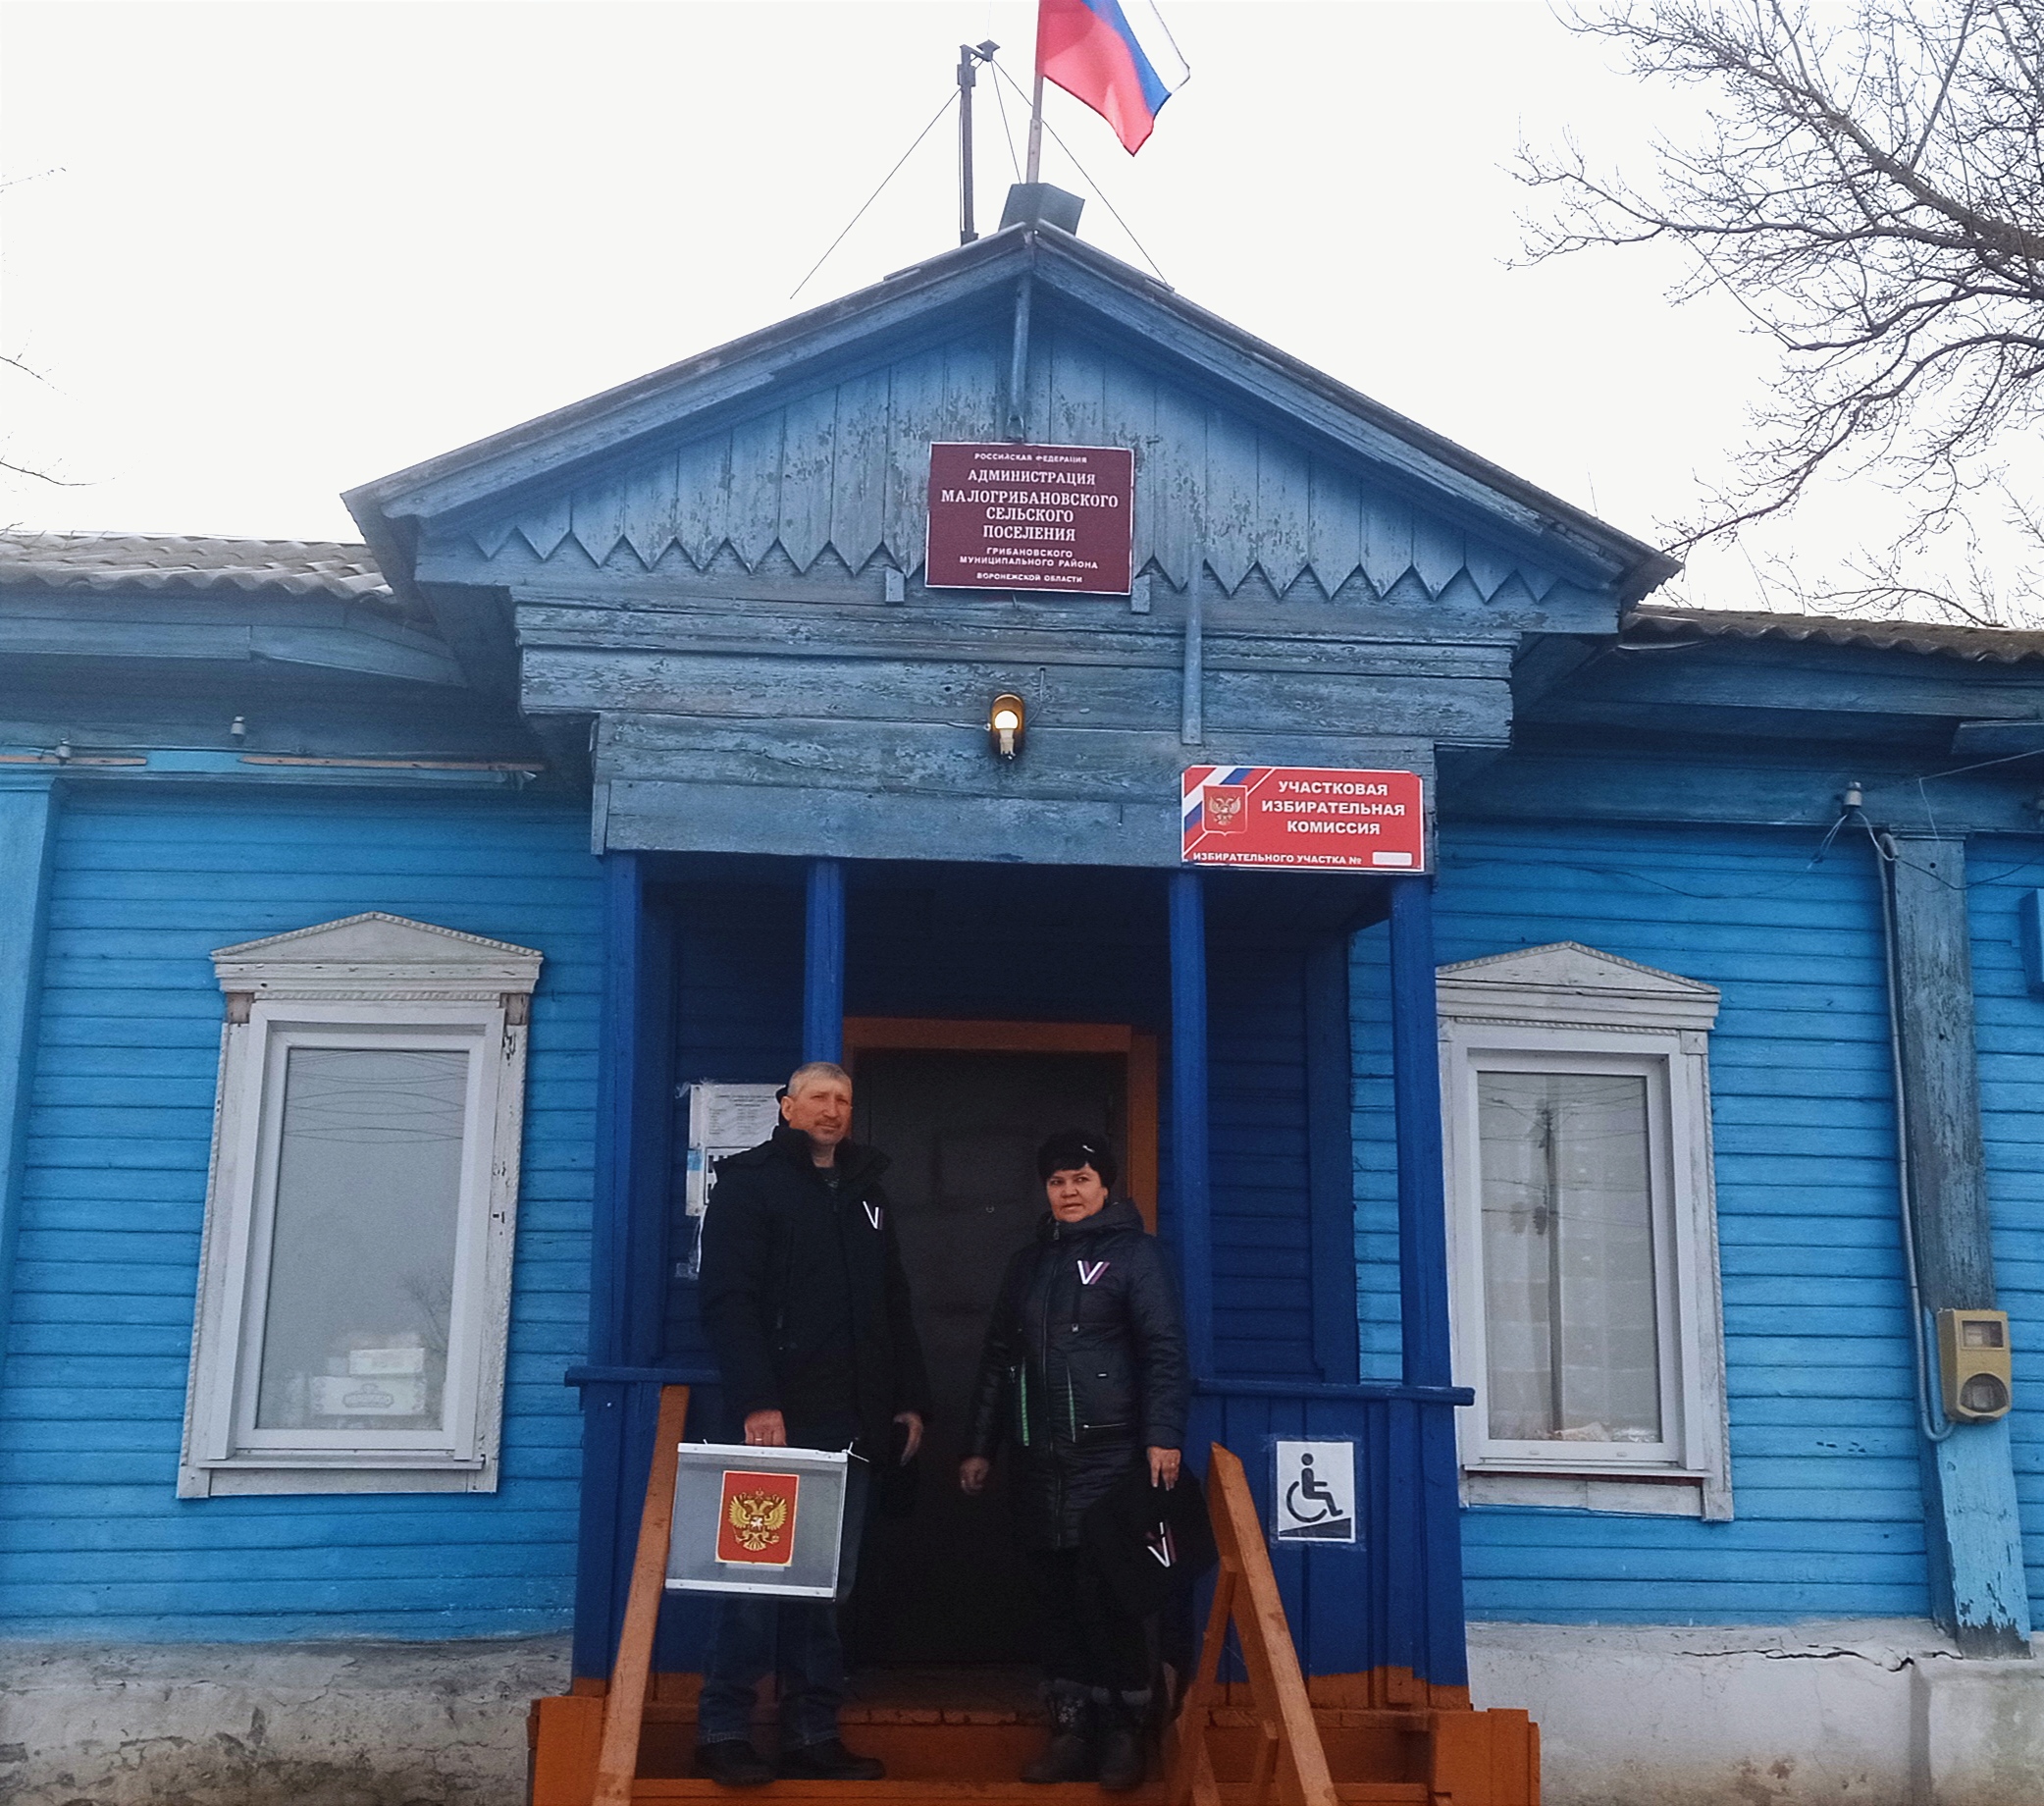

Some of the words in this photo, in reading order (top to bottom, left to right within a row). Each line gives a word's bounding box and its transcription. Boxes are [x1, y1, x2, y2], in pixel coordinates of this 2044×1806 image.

[974, 452, 1032, 461] РОССИЙСКАЯ
[1035, 454, 1087, 463] ФЕДЕРАЦИЯ
[968, 469, 1096, 486] АДМИНИСТРАЦИЯ
[941, 489, 1119, 507] МАЛОГРИБАНОВСКОГО
[986, 506, 1074, 522] СЕЛЬСКОГО
[983, 525, 1076, 541] ПОСЕЛЕНИЯ
[986, 547, 1074, 558] ГРИБАНОВСКОГО
[960, 556, 1055, 567] МУНИЦИПАЛЬНОГО
[1058, 558, 1099, 569] РАЙОНА
[976, 572, 1041, 581] ВОРОНЕЖСКОЙ
[1044, 574, 1083, 583] ОБЛАСТИ
[1278, 780, 1389, 796] УЧАСТКОВАЯ
[1261, 800, 1405, 817] ИЗБИРАТЕЛЬНАЯ
[1286, 821, 1381, 835] КОМИССИЯ
[1192, 852, 1294, 863] ИЗБИРАТЕЛЬНОГО
[1296, 855, 1346, 865] УЧАСТКА
[1349, 856, 1362, 865] №
